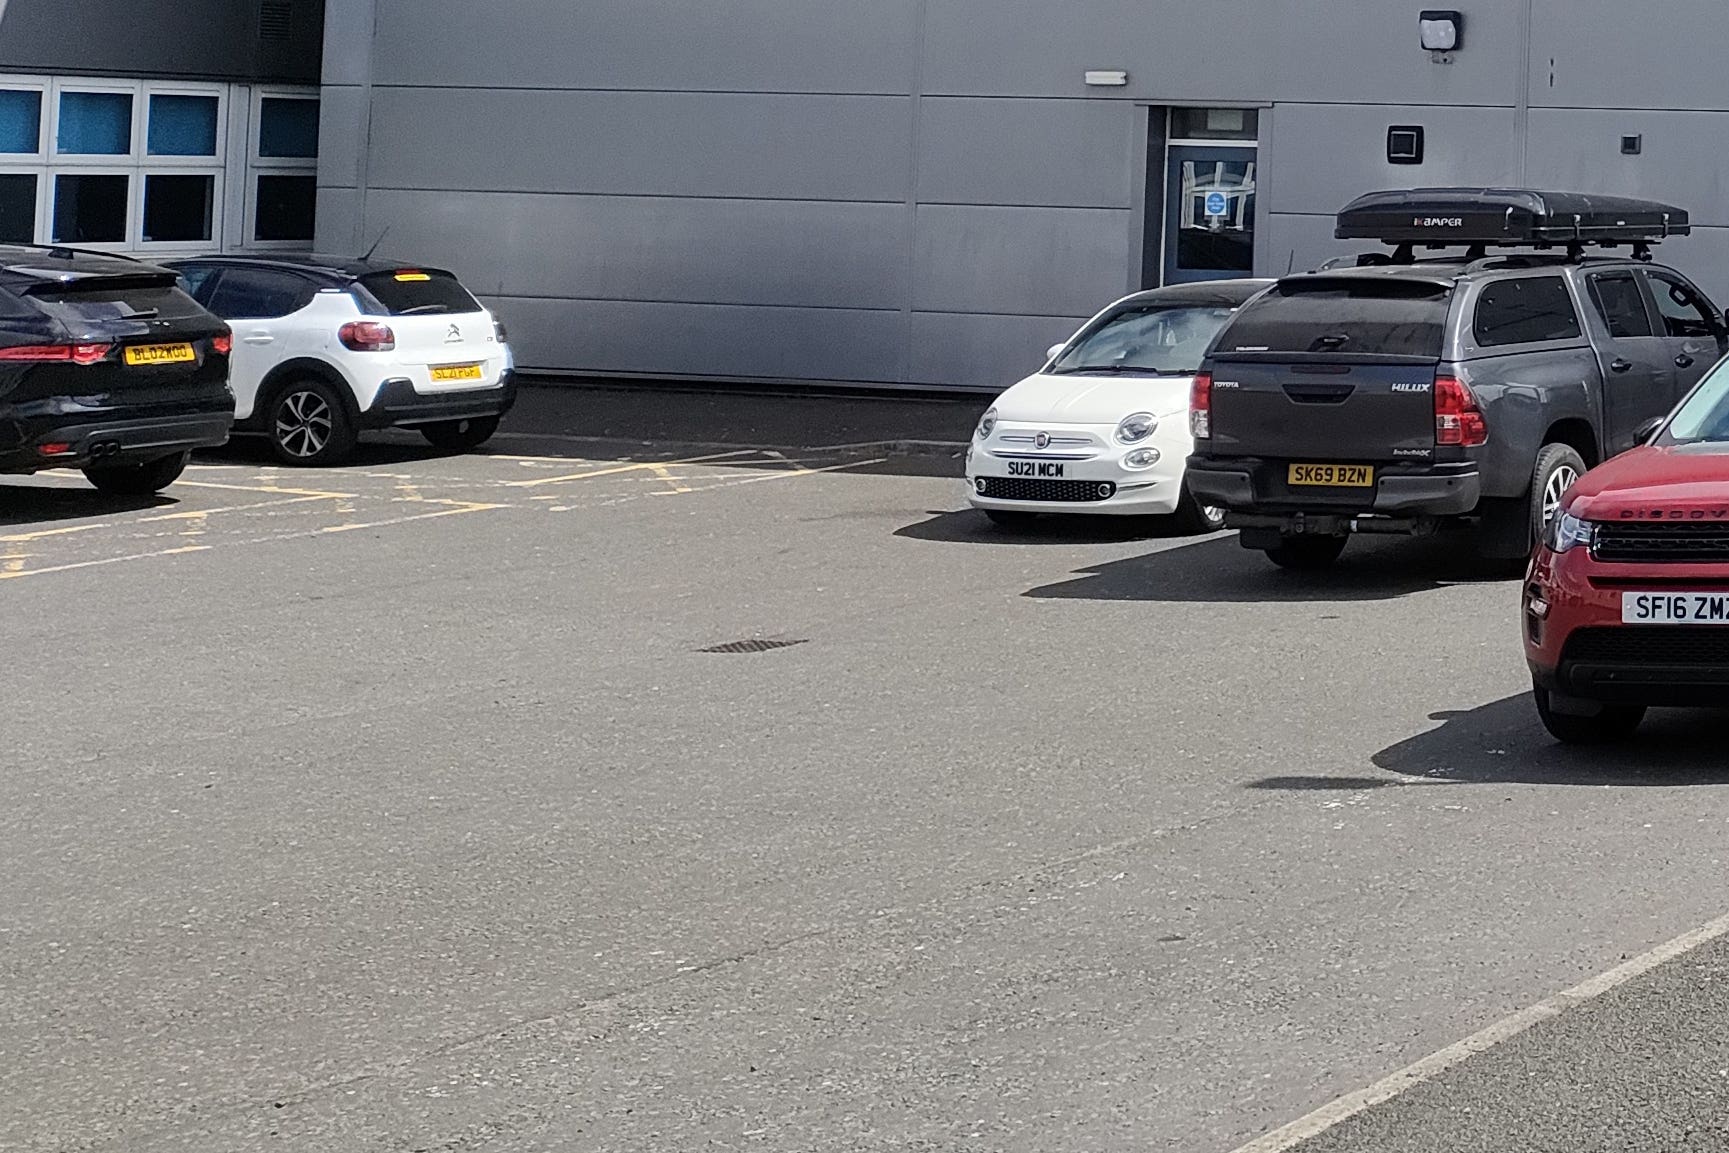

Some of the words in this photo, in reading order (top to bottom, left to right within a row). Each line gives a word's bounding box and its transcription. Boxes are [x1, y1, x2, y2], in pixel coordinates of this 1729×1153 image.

[1391, 383, 1430, 392] HILUX
[1008, 461, 1036, 476] SU21
[1295, 466, 1333, 483] SK69
[1337, 467, 1367, 484] BZN
[1636, 596, 1687, 619] SF16
